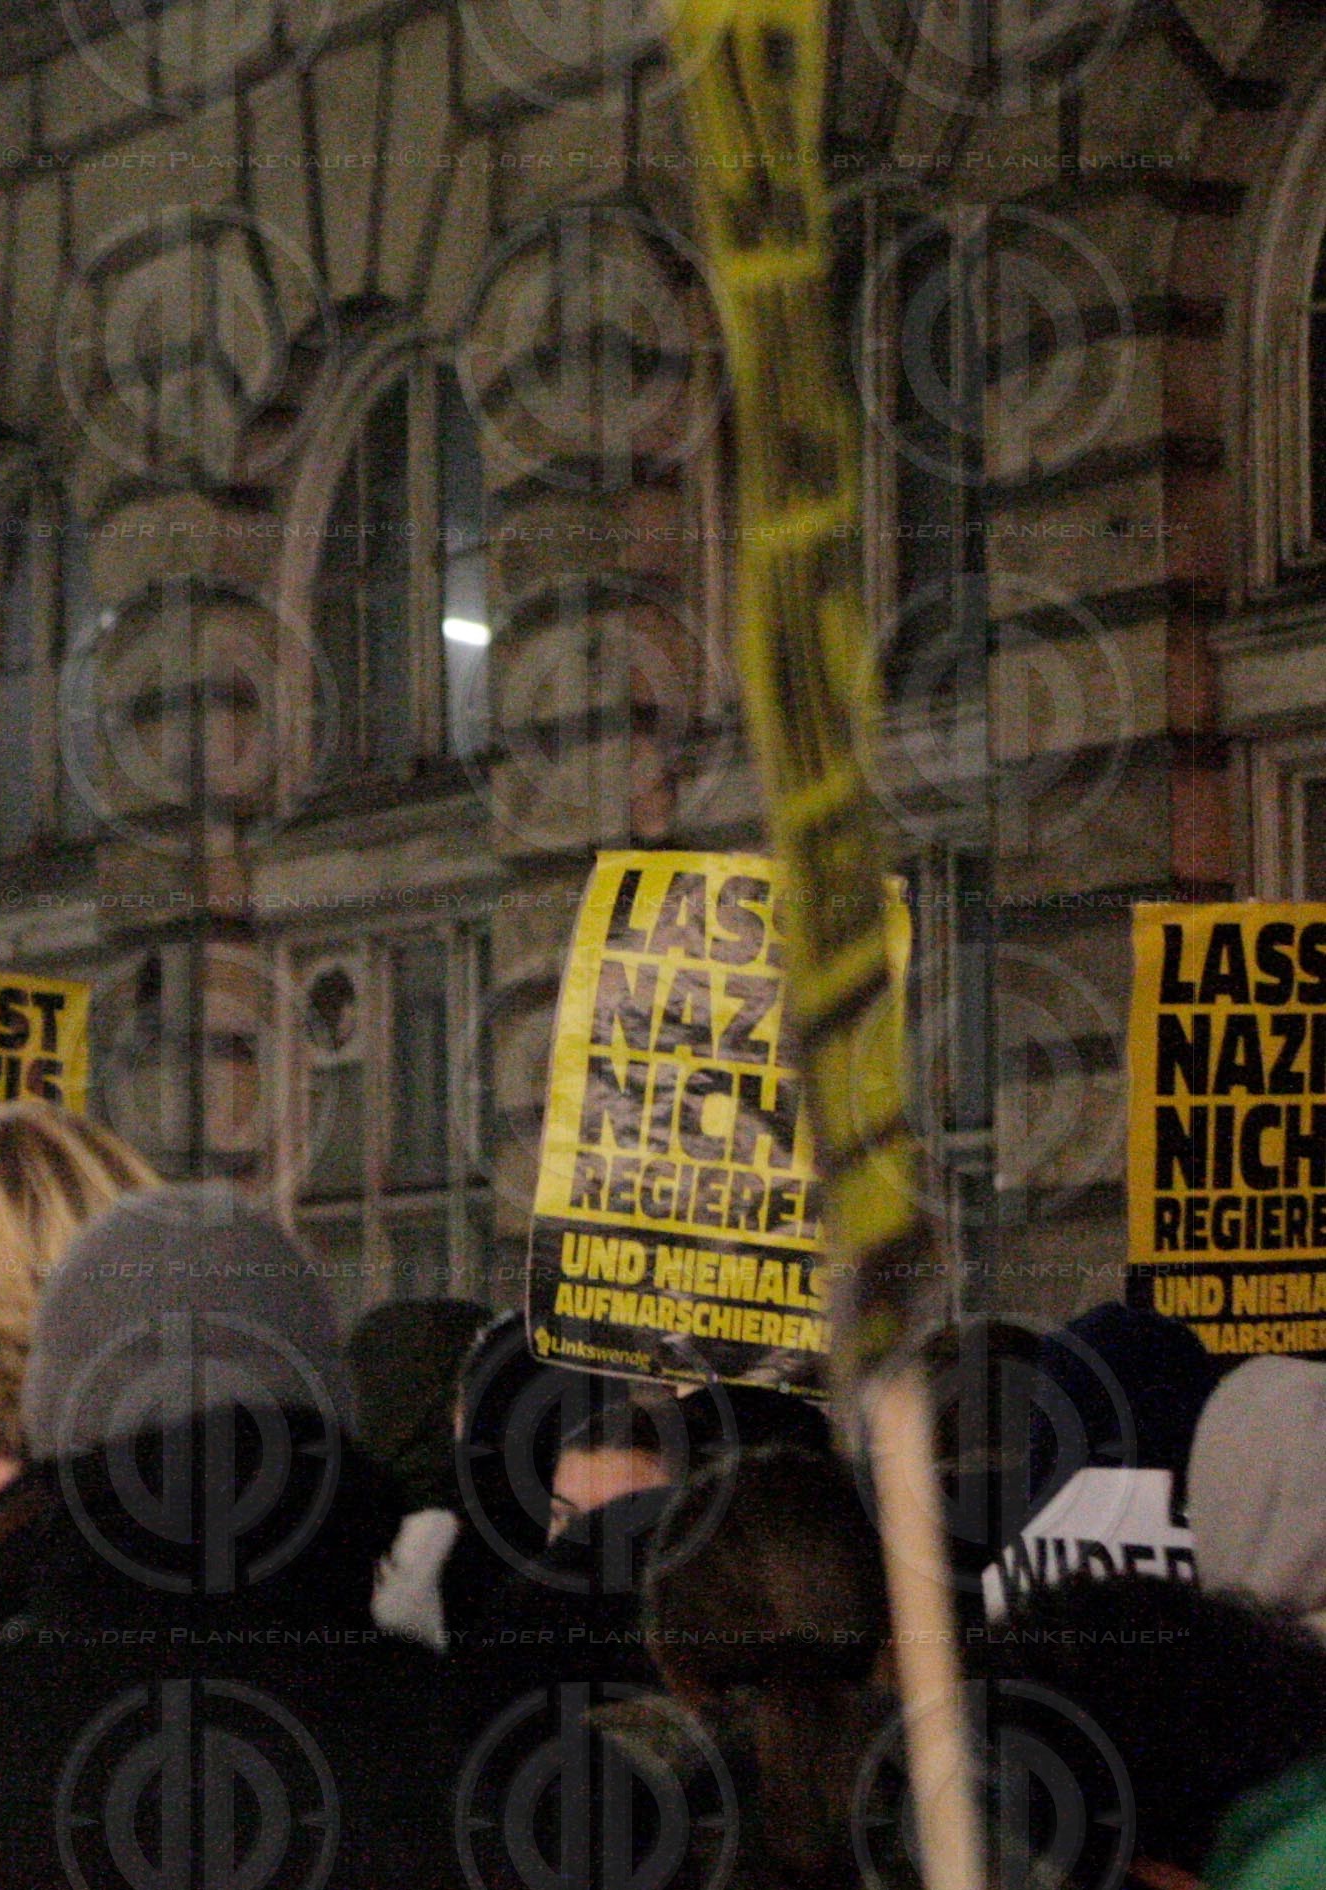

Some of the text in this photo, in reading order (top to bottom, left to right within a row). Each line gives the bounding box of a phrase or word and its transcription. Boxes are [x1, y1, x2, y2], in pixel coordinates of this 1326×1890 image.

[578, 1055, 804, 1170] NICH
[560, 1231, 646, 1287] UND
[1153, 1275, 1224, 1317] UND
